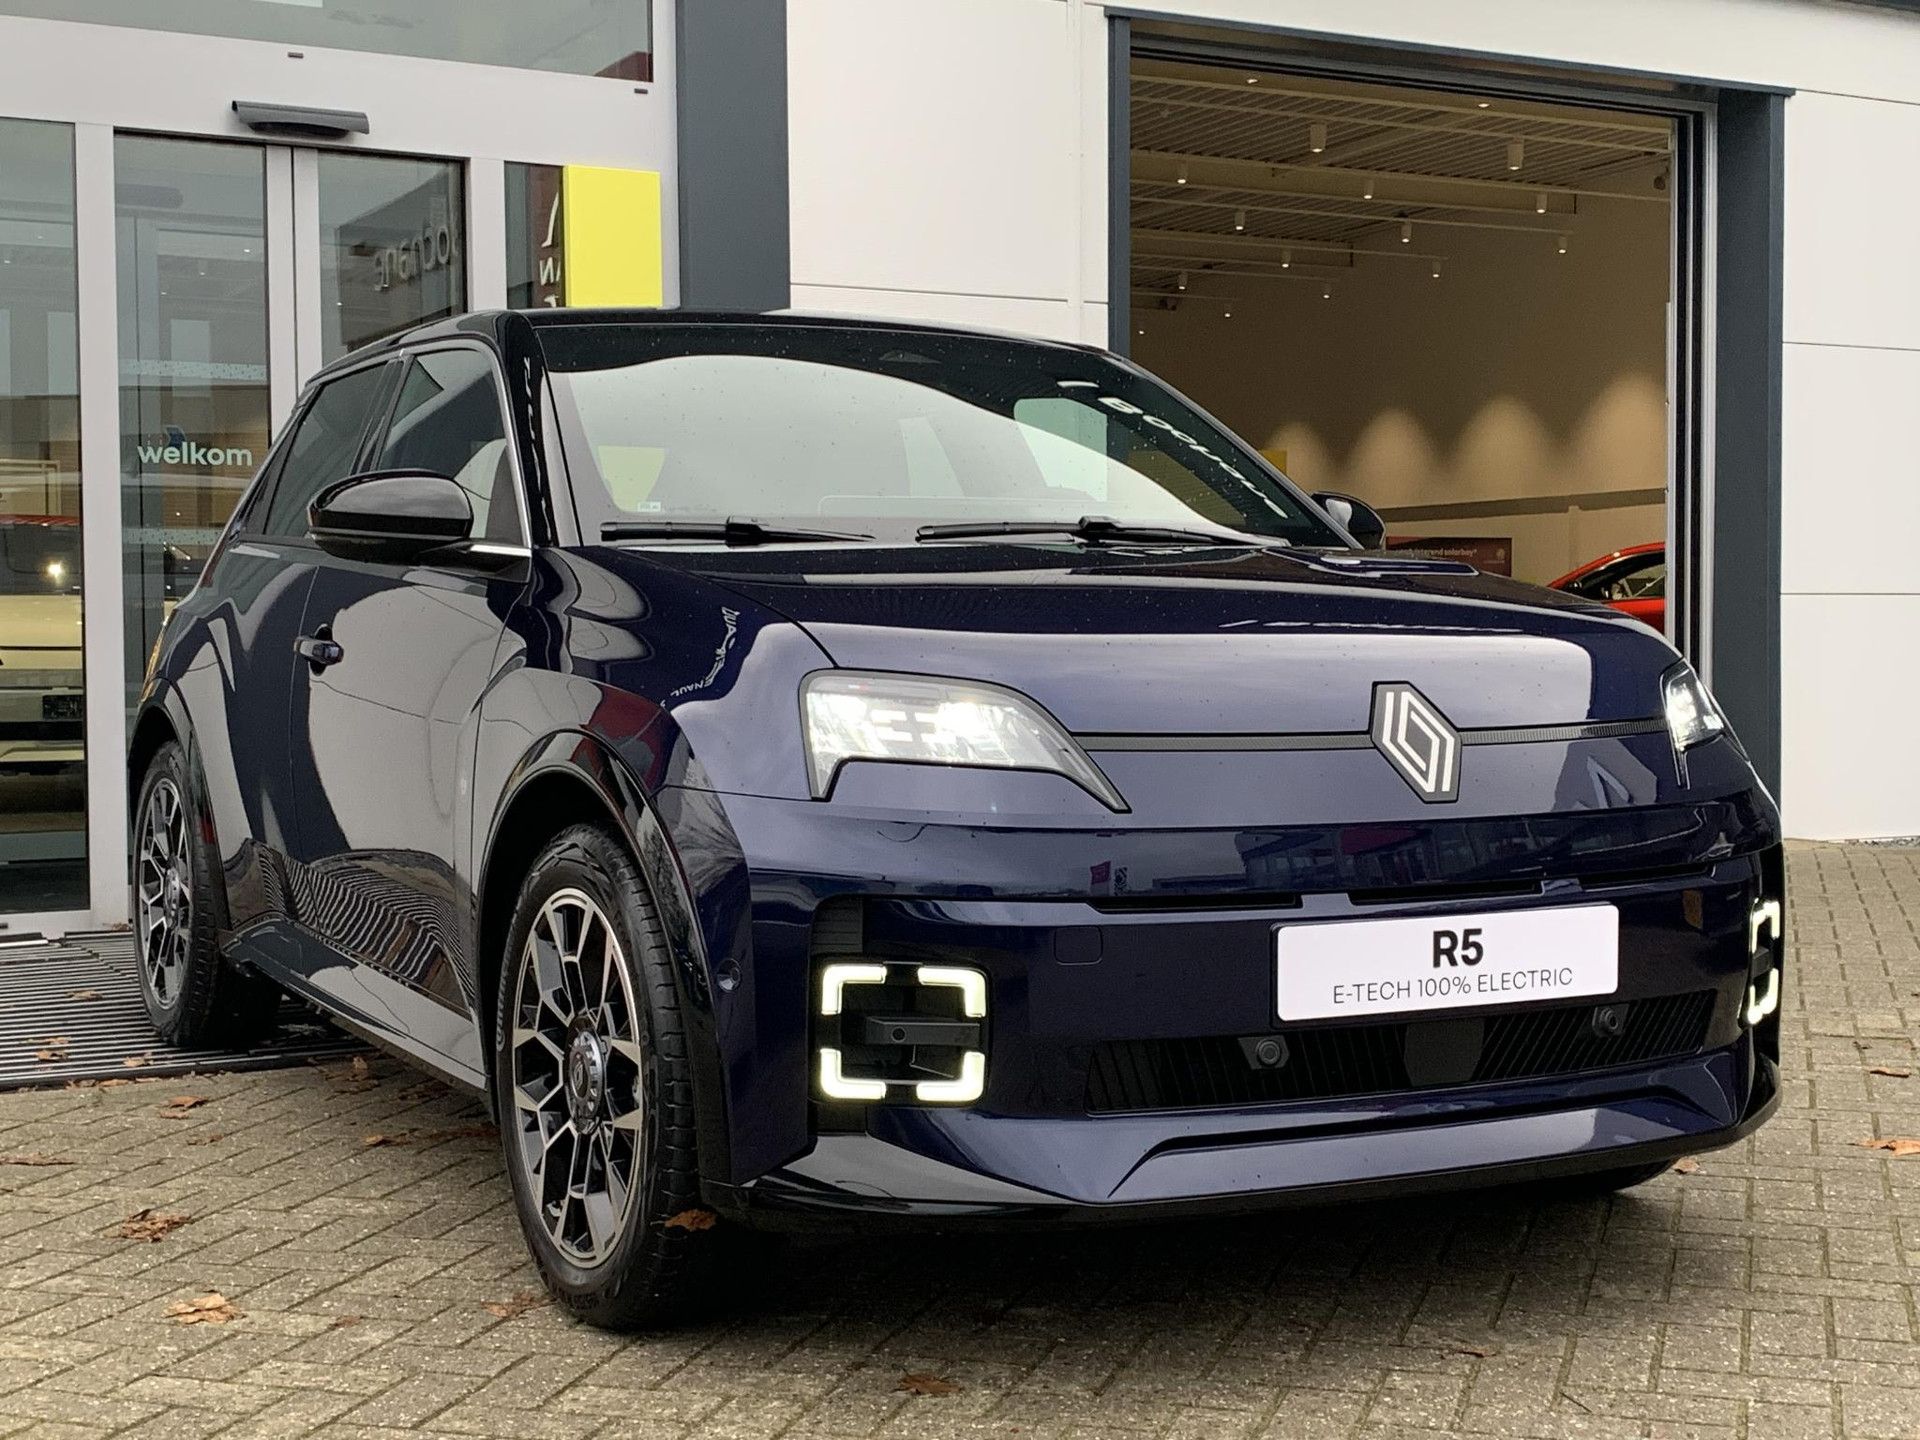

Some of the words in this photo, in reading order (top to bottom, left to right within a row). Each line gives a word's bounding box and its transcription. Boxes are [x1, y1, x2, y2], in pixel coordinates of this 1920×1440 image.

[137, 441, 253, 466] welkom
[1433, 928, 1484, 968] R5
[1333, 980, 1411, 1004] E-TECH
[1418, 976, 1471, 997] 100%
[1478, 967, 1573, 992] ELECTRIC
